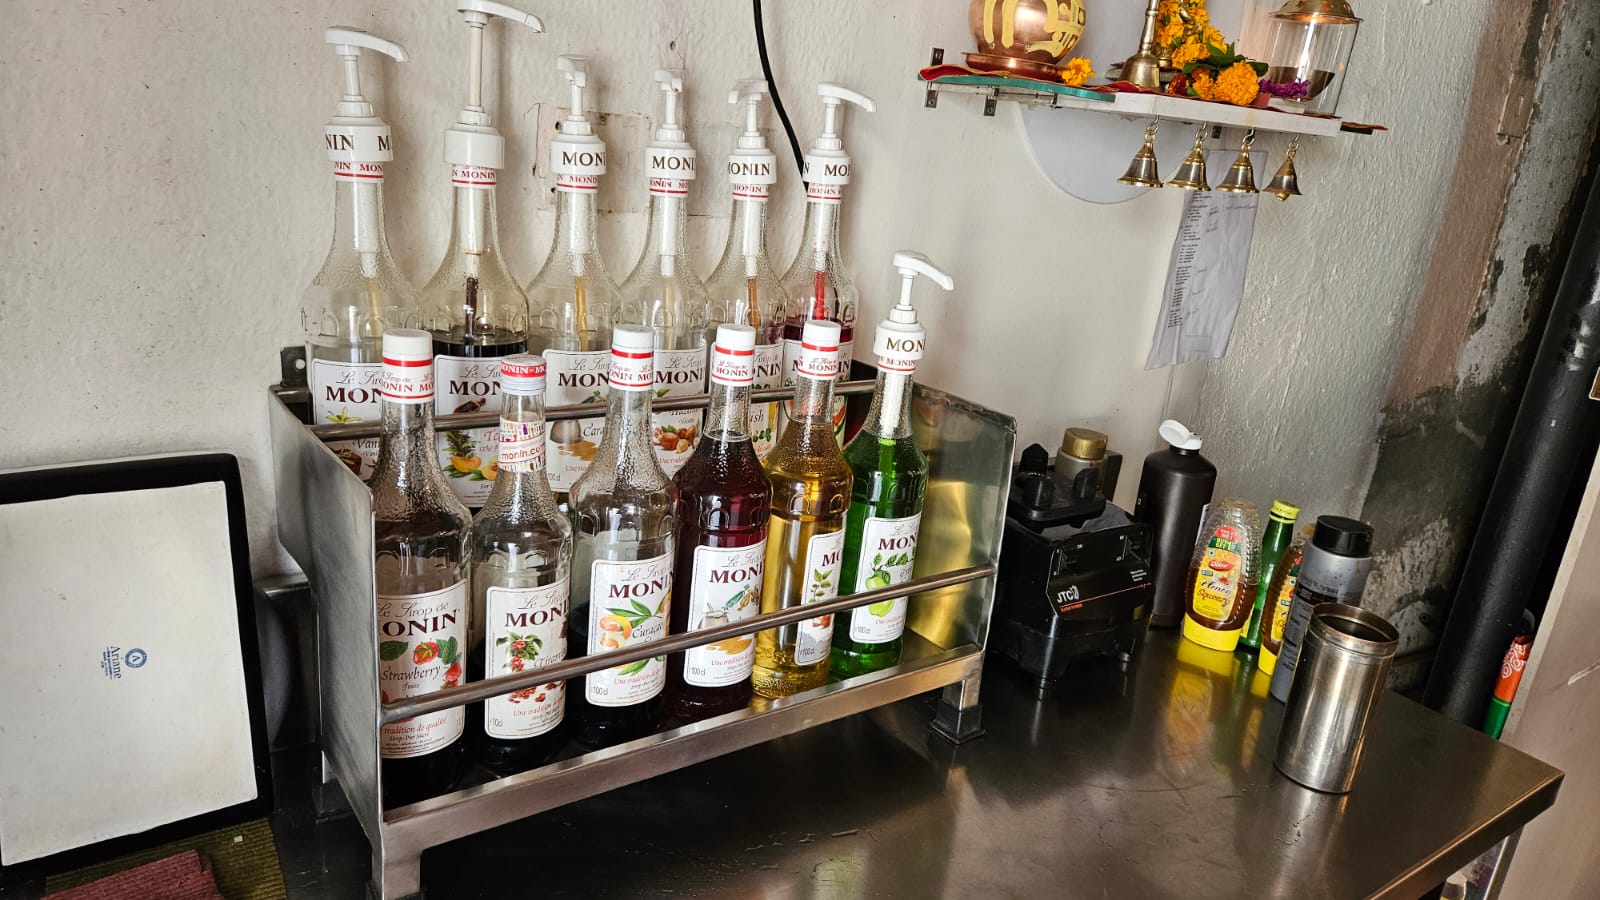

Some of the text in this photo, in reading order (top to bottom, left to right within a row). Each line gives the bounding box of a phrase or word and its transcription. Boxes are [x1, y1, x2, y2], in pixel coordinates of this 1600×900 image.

[1056, 590, 1073, 603] JTC
[379, 608, 459, 637] ONIN
[381, 665, 441, 681] Strawberry
